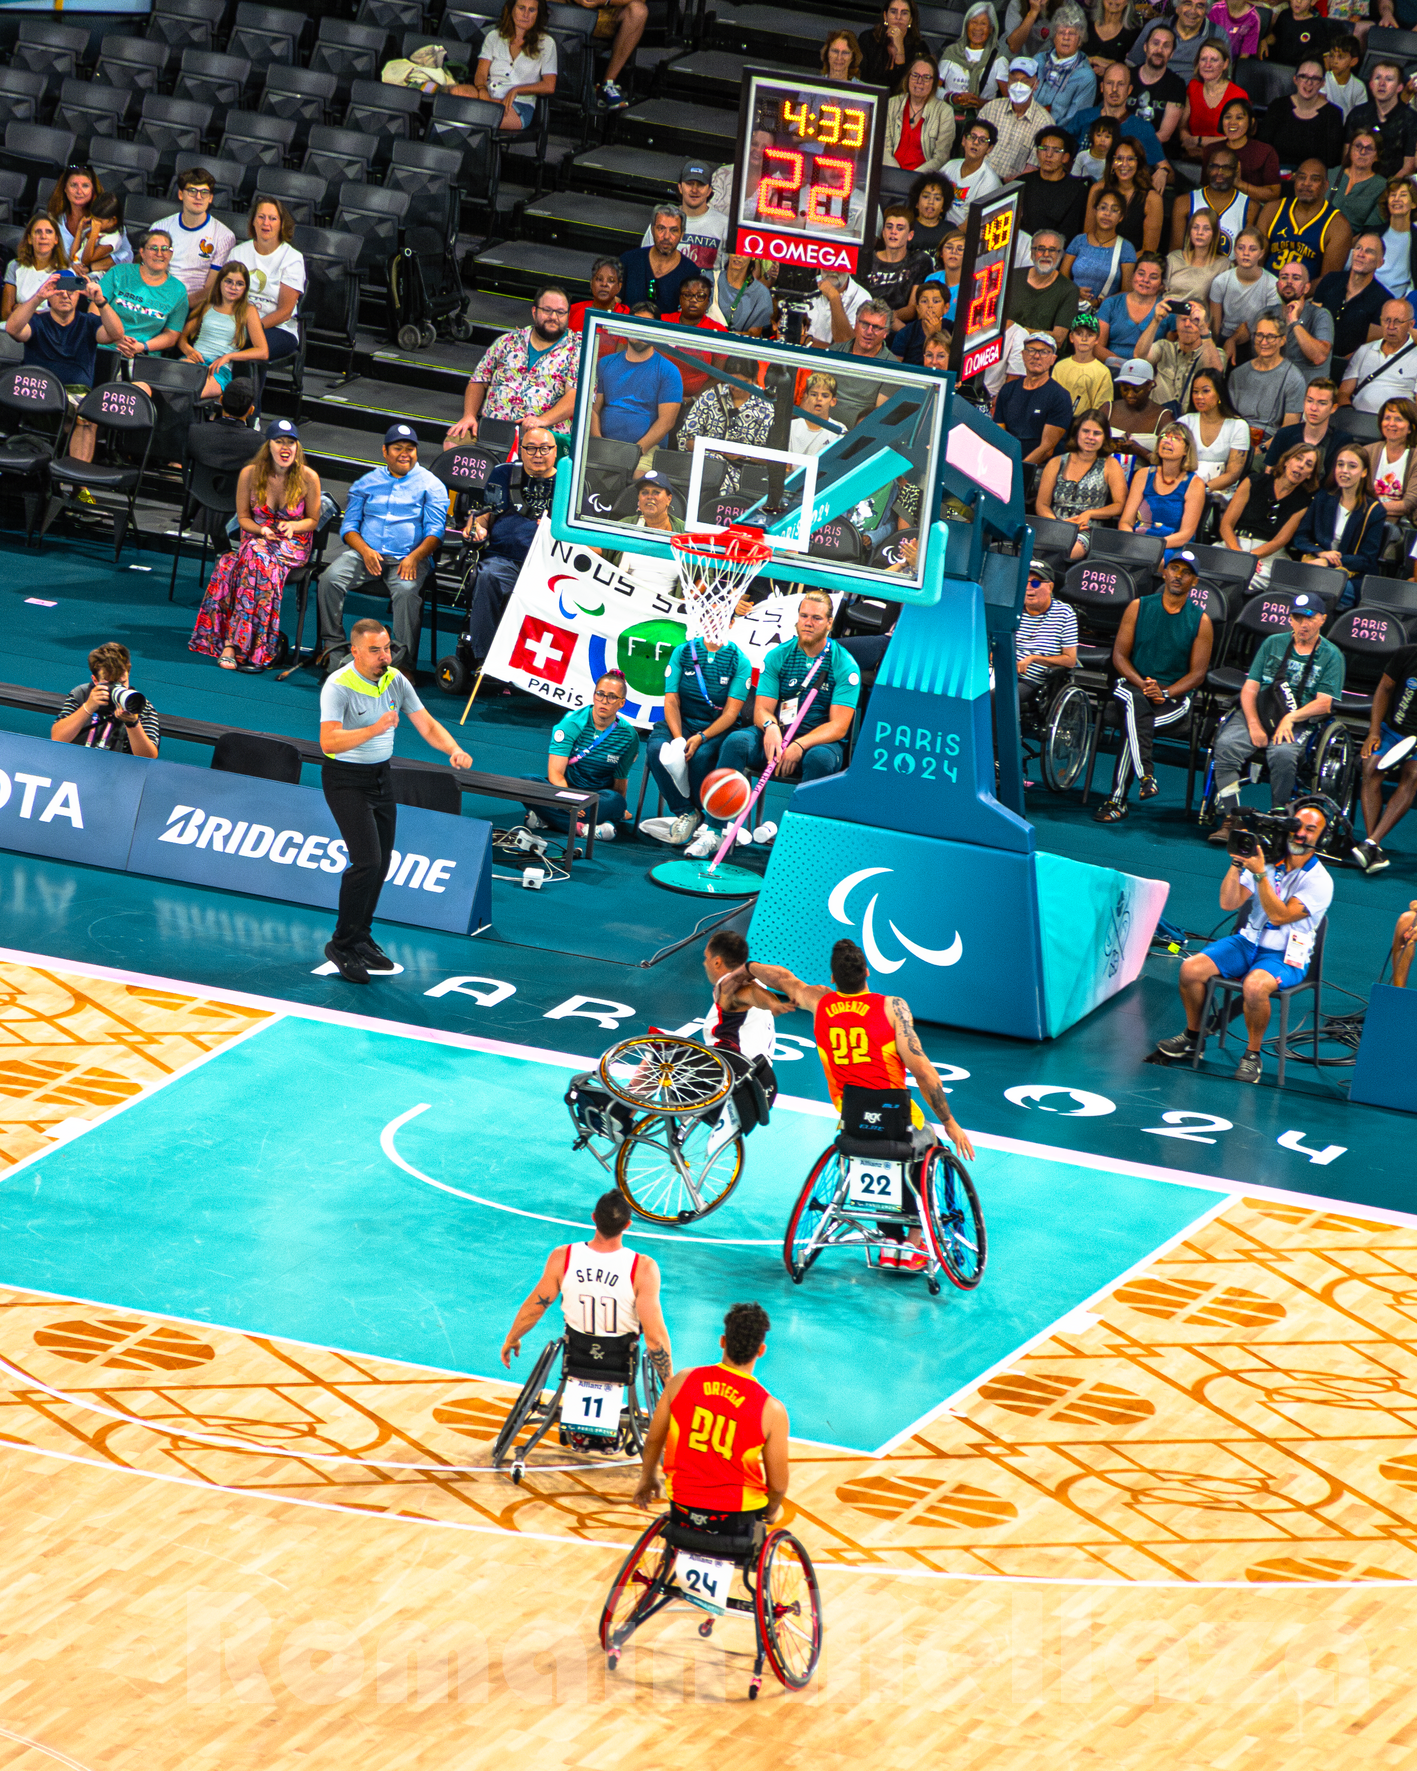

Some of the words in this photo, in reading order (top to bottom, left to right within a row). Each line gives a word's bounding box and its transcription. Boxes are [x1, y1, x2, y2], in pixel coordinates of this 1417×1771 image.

[783, 100, 866, 148] 4:33
[757, 147, 854, 228] 22
[769, 239, 852, 270] OMEGA
[1272, 249, 1303, 270] 30
[965, 260, 1005, 335] 22
[973, 344, 1000, 372] OMEGA
[12, 386, 46, 400] 2024
[101, 402, 135, 416] 2024
[451, 465, 485, 480] 2024
[1080, 580, 1115, 595] 2024
[1351, 628, 1386, 642] 2024
[872, 748, 958, 784] 2024
[0, 768, 84, 830] TA
[157, 804, 457, 894] BRIDGESNE
[825, 1000, 871, 1018] LORENZO
[829, 1026, 872, 1065] 22
[860, 1172, 891, 1196] 22
[576, 1268, 619, 1287] SERIO
[579, 1293, 617, 1335] 11
[582, 1396, 603, 1418] 11
[703, 1381, 746, 1408] ORTEGA
[688, 1404, 738, 1462] 24
[685, 1569, 718, 1598] 24
